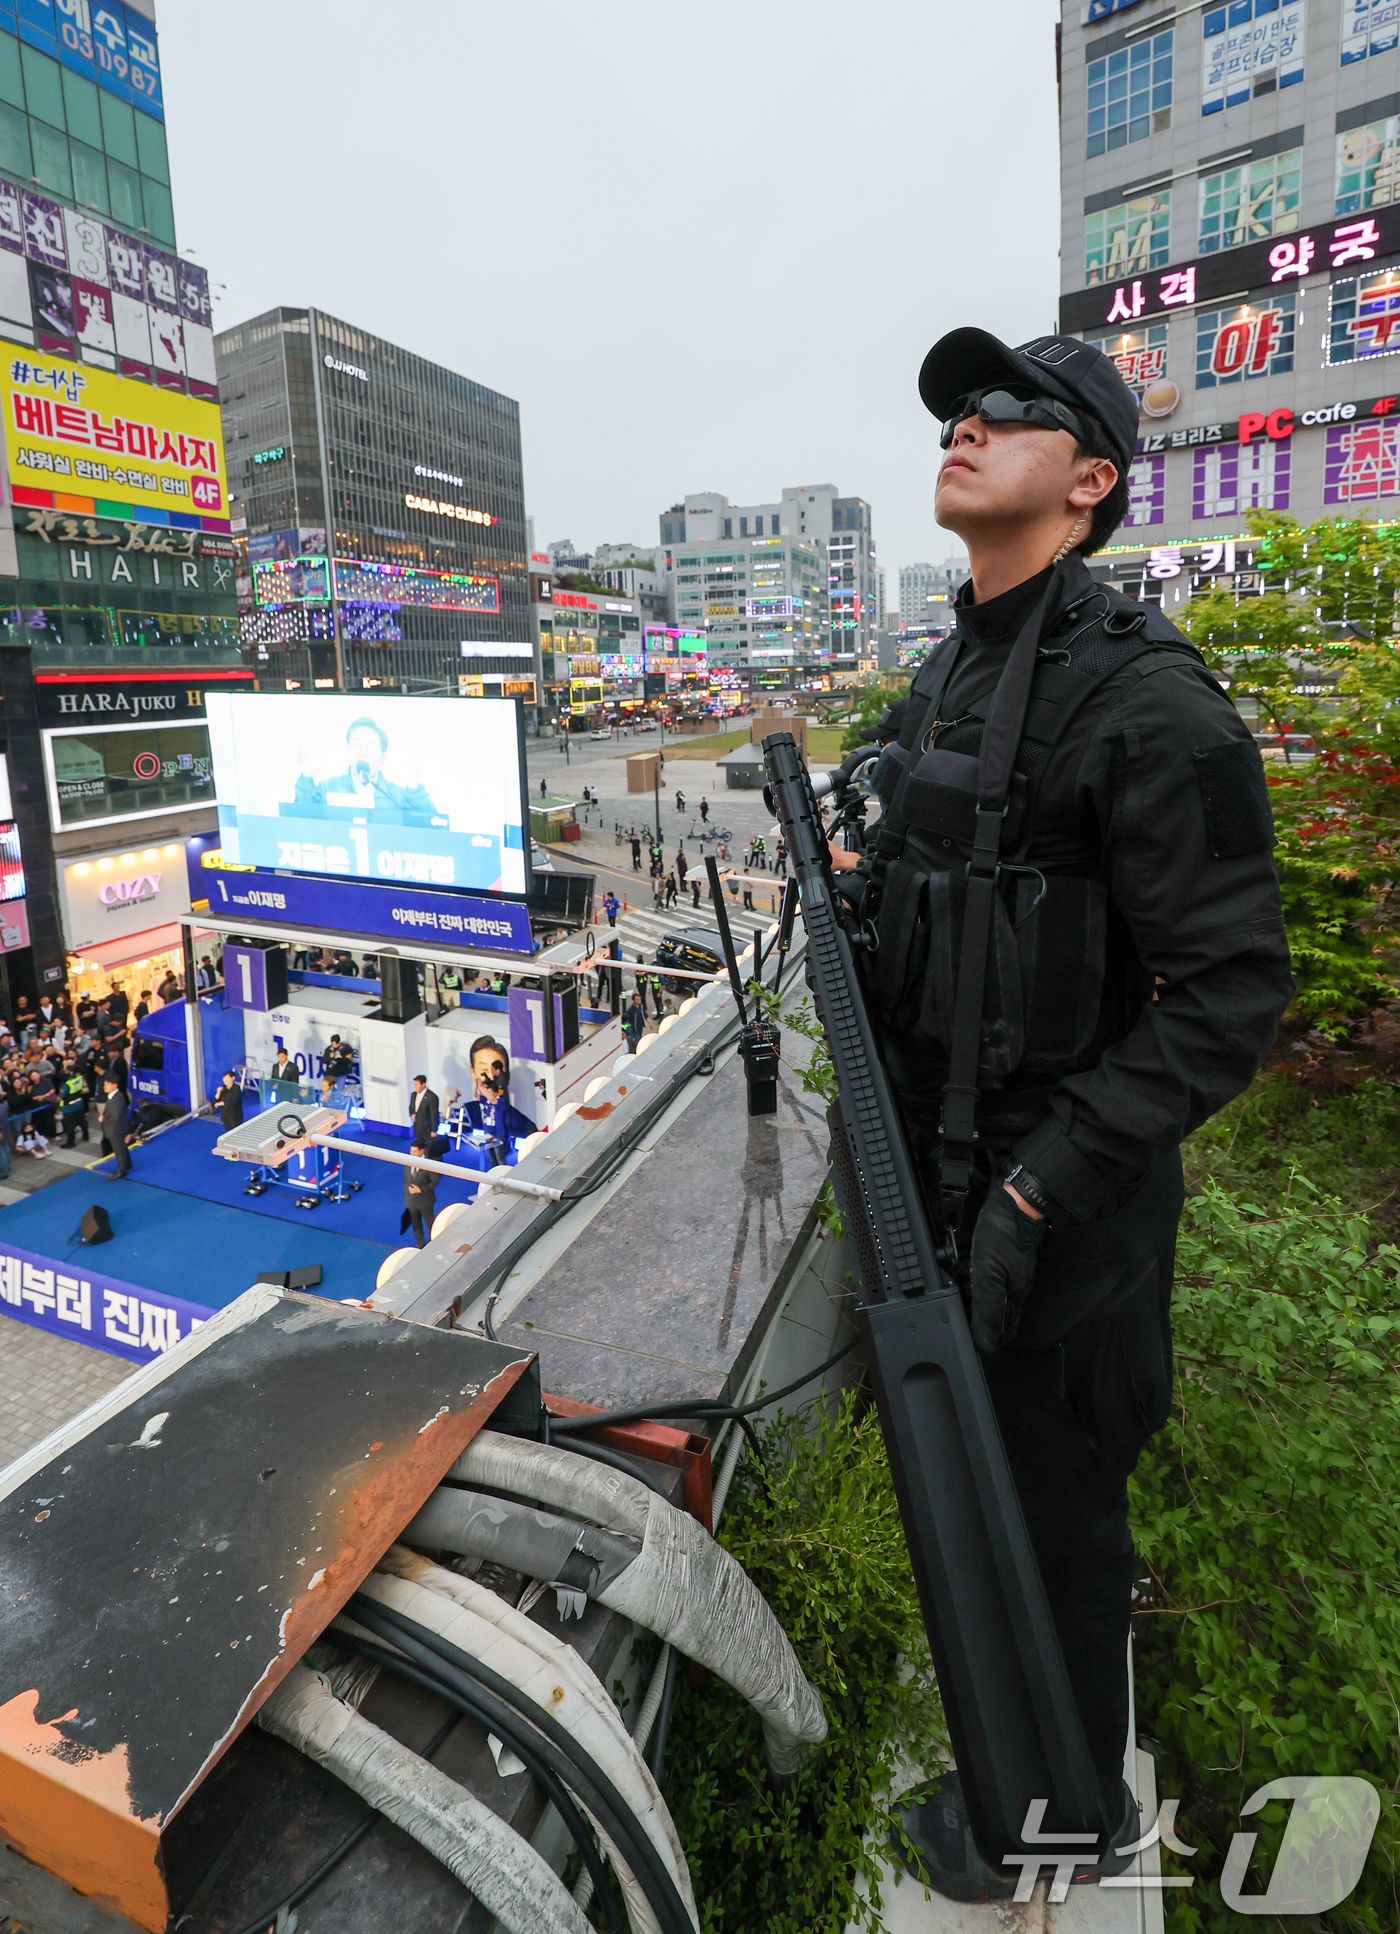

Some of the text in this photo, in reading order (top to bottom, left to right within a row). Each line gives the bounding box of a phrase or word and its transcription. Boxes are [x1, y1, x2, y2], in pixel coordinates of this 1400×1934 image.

[1211, 13, 1299, 61] 골프존이 만든
[61, 22, 157, 95] 031)987
[1208, 33, 1298, 85] 골프연습장
[1106, 266, 1197, 323] 사격
[1211, 307, 1283, 378] 야
[11, 361, 87, 402] #더샵
[342, 362, 369, 382] HOTEL
[14, 392, 217, 474] 베트남마사지
[1171, 424, 1223, 447] 브리즈
[1238, 408, 1295, 443] PC
[1301, 402, 1357, 426] cafe
[1371, 396, 1397, 415] 4F
[17, 448, 71, 475] 샤워실
[161, 477, 189, 497] 완비
[193, 481, 219, 505] 4F
[405, 493, 439, 514] CASA
[439, 501, 455, 518] PC
[455, 506, 483, 524] CLUB
[70, 549, 200, 589] HAIR
[531, 552, 550, 565] MOTEL
[58, 692, 177, 718] HARAJUKU
[133, 751, 209, 780] OPEN
[278, 828, 456, 884] 지금은 1 이재명
[99, 872, 163, 905] COZY
[107, 901, 131, 913] pajama
[139, 895, 156, 903] inner
[217, 880, 229, 902] 1
[248, 890, 287, 910] 이재명
[391, 908, 513, 938] 이제부터 진짜 대한민국
[237, 954, 252, 1003] 1
[271, 1013, 290, 1024] 민주당
[526, 999, 545, 1054] 1
[297, 1149, 306, 1170] 1
[103, 1288, 182, 1353] 진짜
